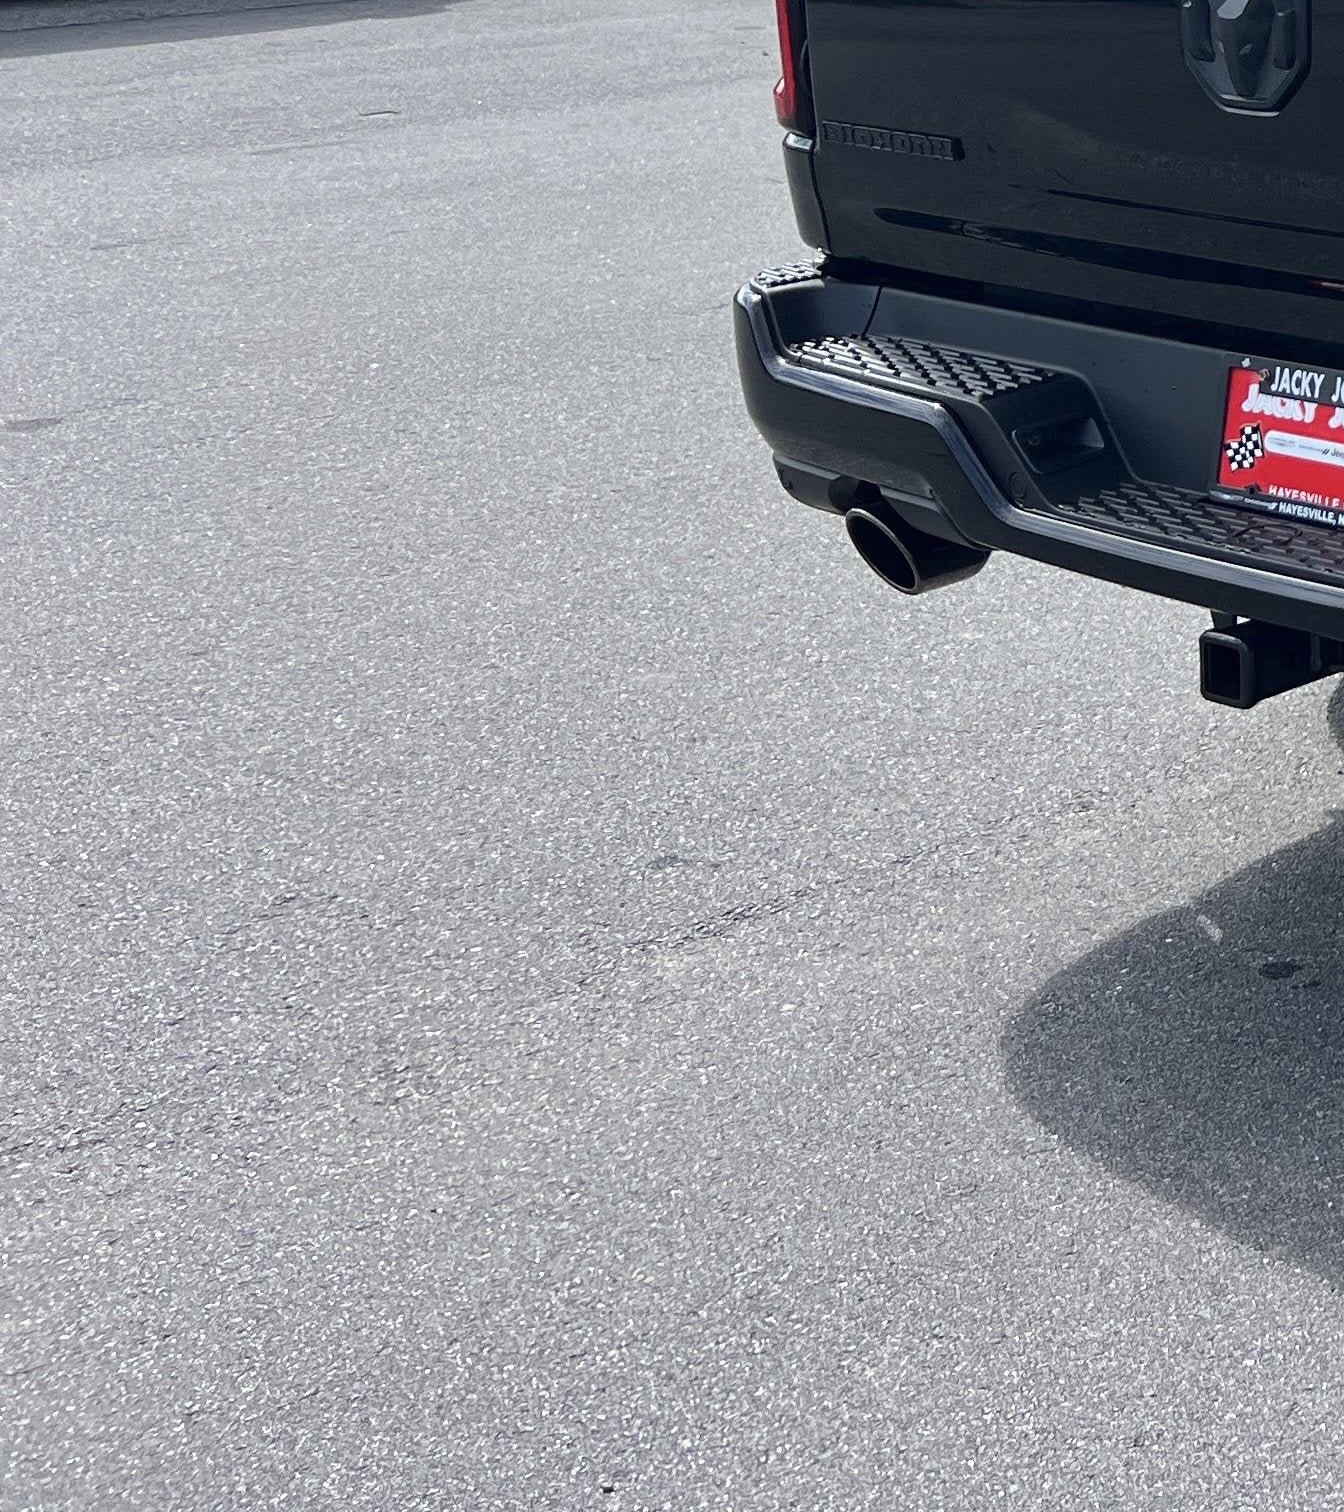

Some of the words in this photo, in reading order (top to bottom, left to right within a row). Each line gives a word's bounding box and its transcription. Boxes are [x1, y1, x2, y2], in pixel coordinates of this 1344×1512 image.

[1270, 366, 1326, 399] JACKY
[1241, 383, 1319, 424] JACKY
[1279, 501, 1336, 526] HAYESVILLE,
